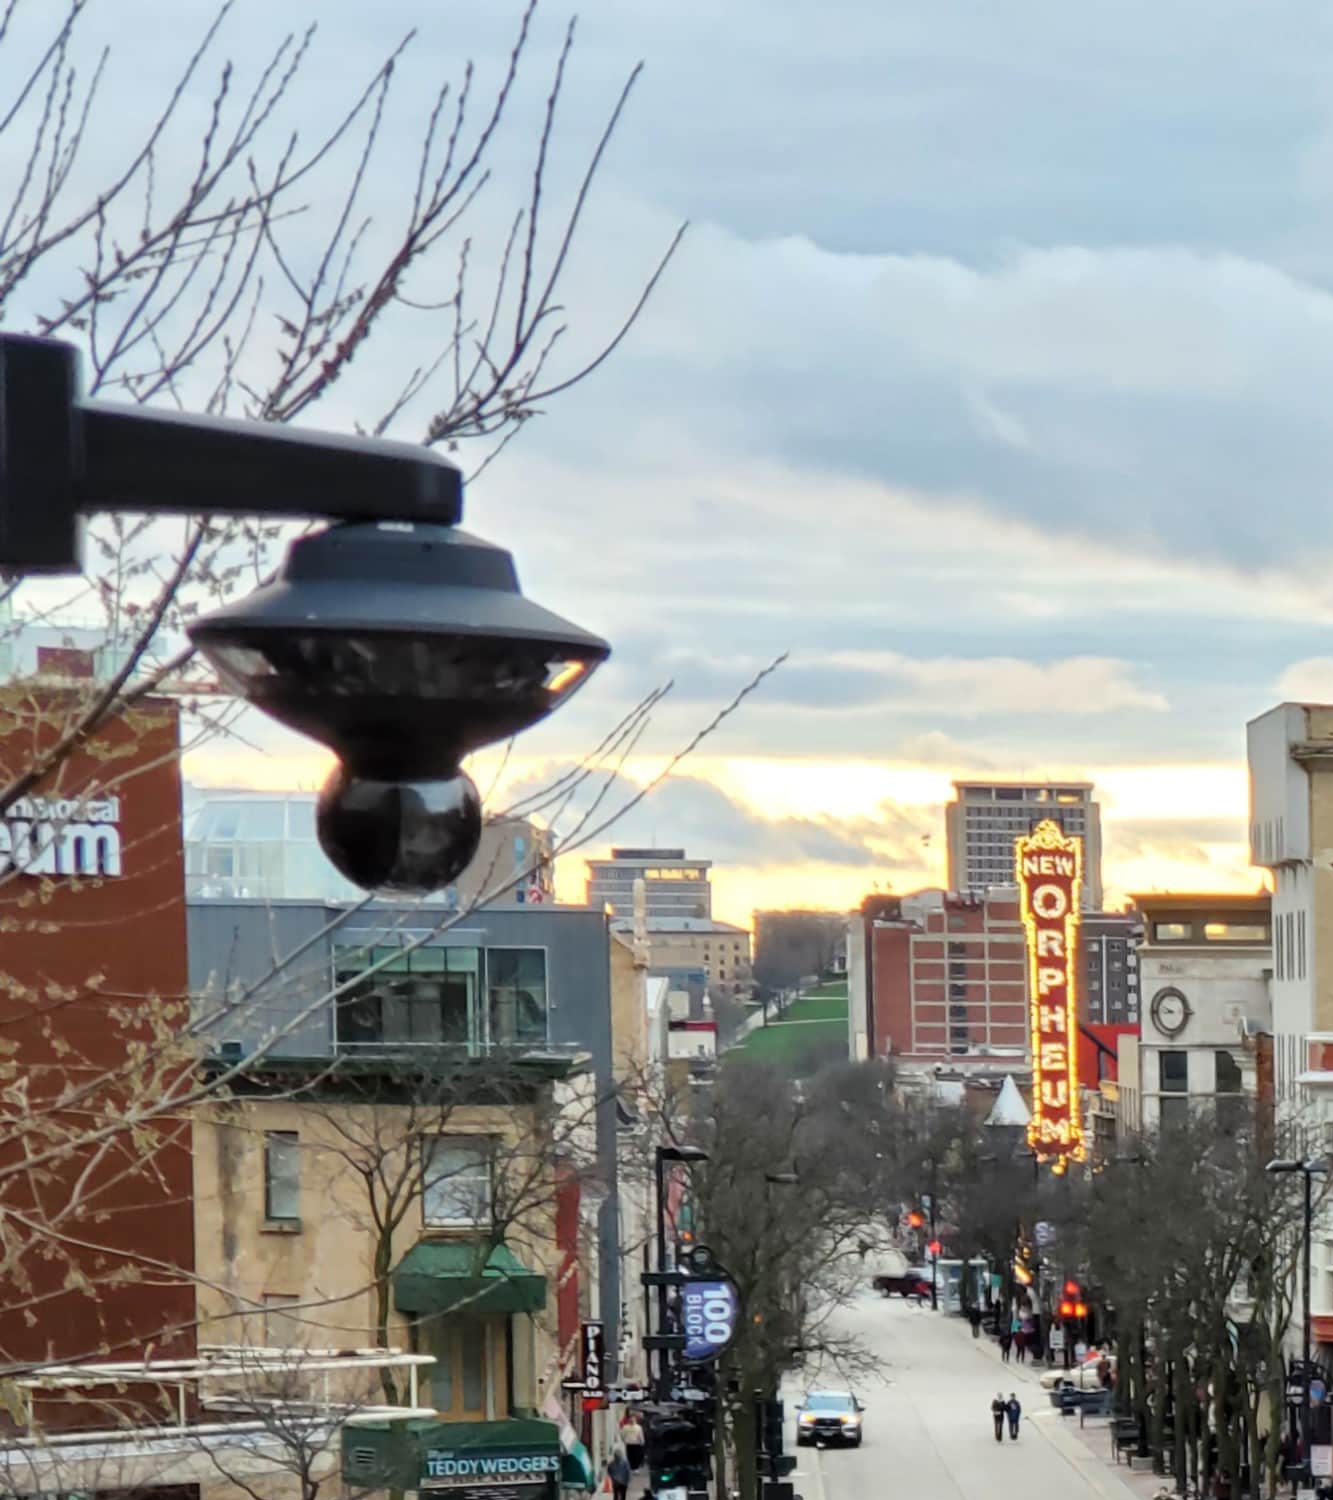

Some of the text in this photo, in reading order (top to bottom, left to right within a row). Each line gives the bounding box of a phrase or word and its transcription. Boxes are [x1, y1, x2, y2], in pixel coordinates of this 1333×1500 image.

[1022, 856, 1074, 877] NEW
[1032, 884, 1070, 1144] ORPHEUM
[685, 1293, 703, 1346] BLOCK
[703, 1284, 732, 1344] 100
[586, 1325, 601, 1388] PIANO
